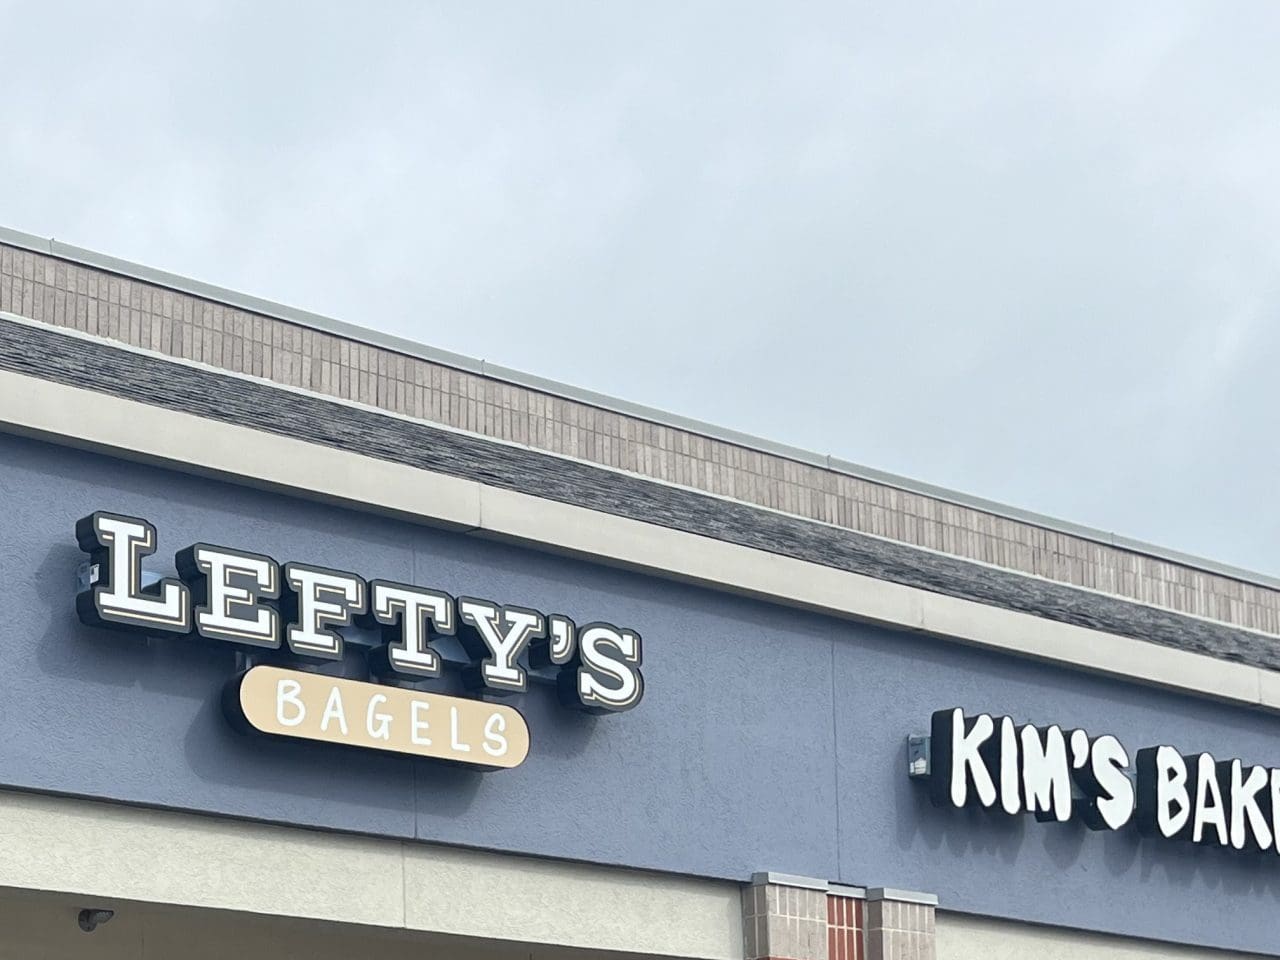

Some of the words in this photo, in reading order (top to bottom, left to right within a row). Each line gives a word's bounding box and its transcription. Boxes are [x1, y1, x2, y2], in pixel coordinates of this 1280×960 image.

[94, 513, 643, 709] LEFTY'S
[275, 679, 509, 757] BAGELS
[949, 706, 1135, 831] KIM'S
